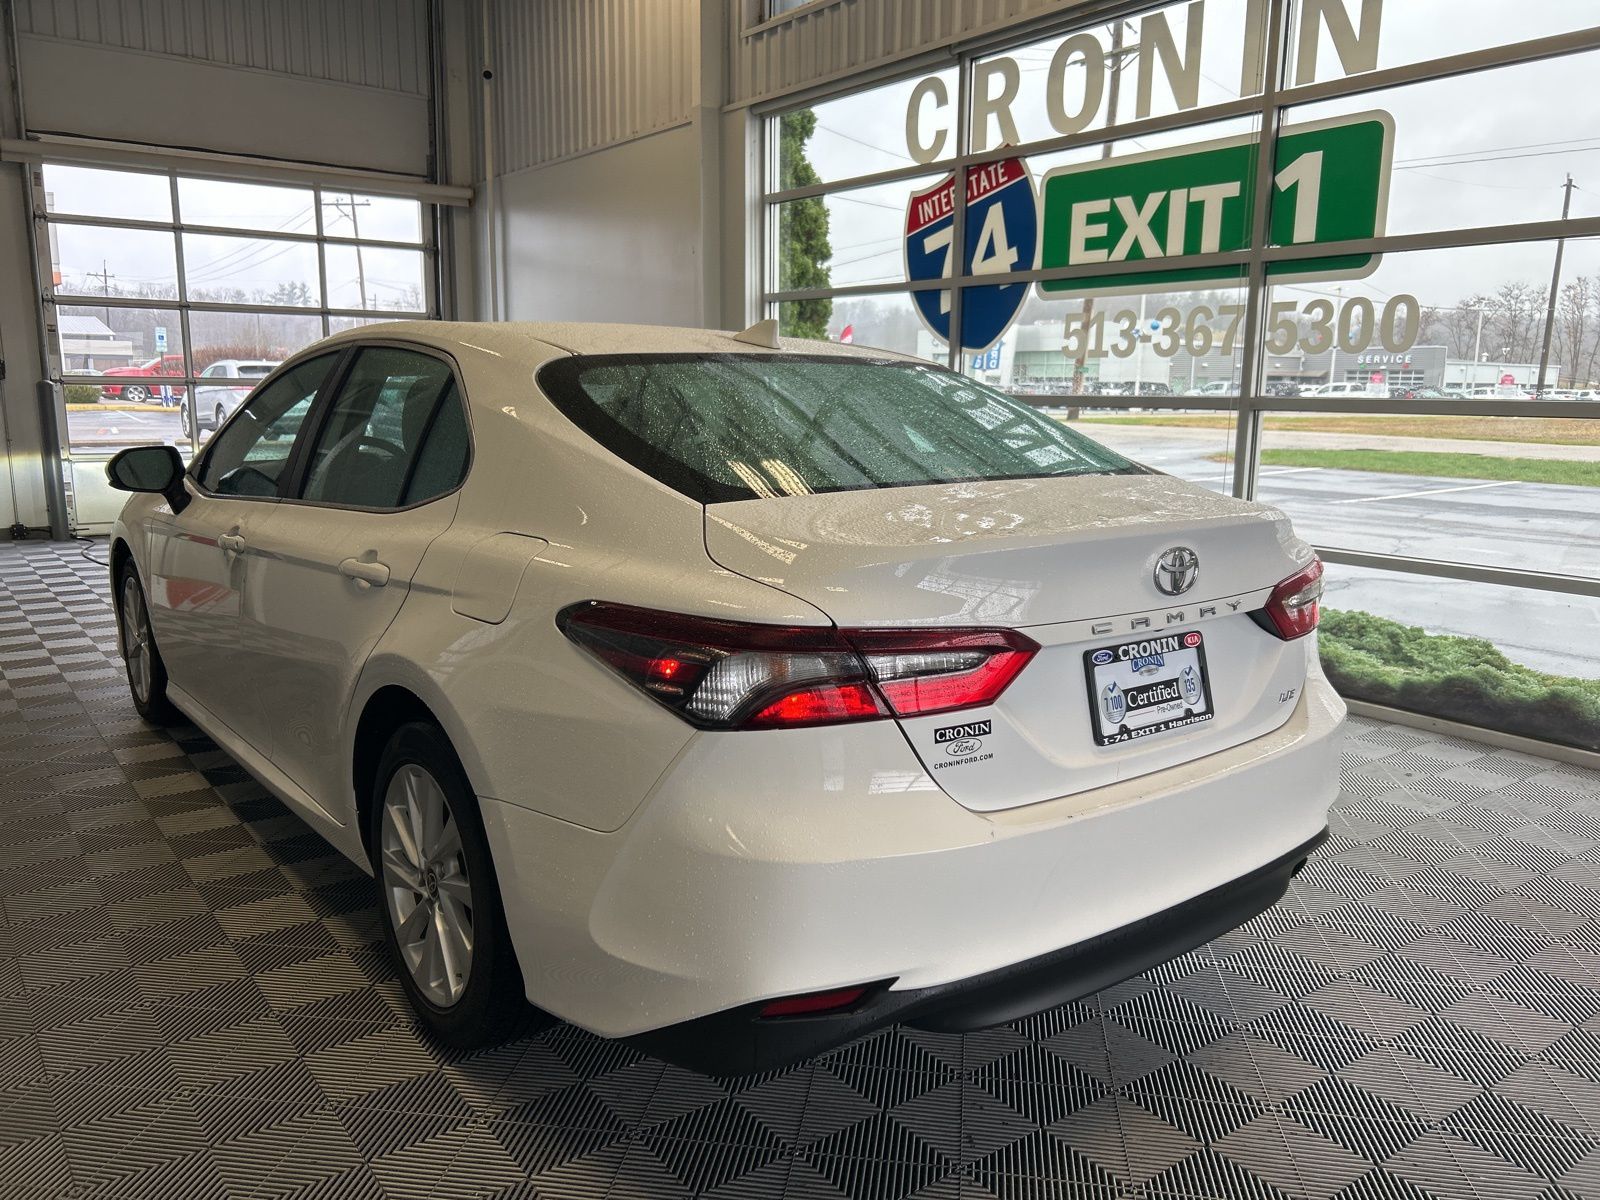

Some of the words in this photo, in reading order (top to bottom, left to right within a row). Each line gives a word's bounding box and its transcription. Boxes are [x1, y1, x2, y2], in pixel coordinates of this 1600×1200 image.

[905, 0, 1381, 164] CRONIN
[918, 160, 1008, 224] INTERTATE
[1069, 181, 1241, 265] EXIT
[1274, 150, 1323, 243] 1
[923, 201, 1018, 314] 74
[1061, 294, 1420, 359] 513-3675300
[1357, 354, 1412, 364] SERVICE
[1091, 600, 1242, 635] CAMRY
[1118, 636, 1179, 661] CRONIN
[1186, 635, 1200, 645] KIA
[1095, 651, 1112, 662] Ford
[1132, 654, 1164, 671] CRONIN
[1127, 682, 1179, 707] Certified
[1184, 678, 1196, 693] 135
[1156, 702, 1183, 714] Pre-Owned
[936, 721, 990, 741] CRONIN
[1103, 733, 1129, 745] I-74
[1131, 726, 1157, 738] EXIT
[1159, 723, 1167, 731] 1
[1169, 713, 1212, 728] Harrison
[951, 739, 977, 754] Ford
[934, 752, 994, 770] CRONINFORD.COM
